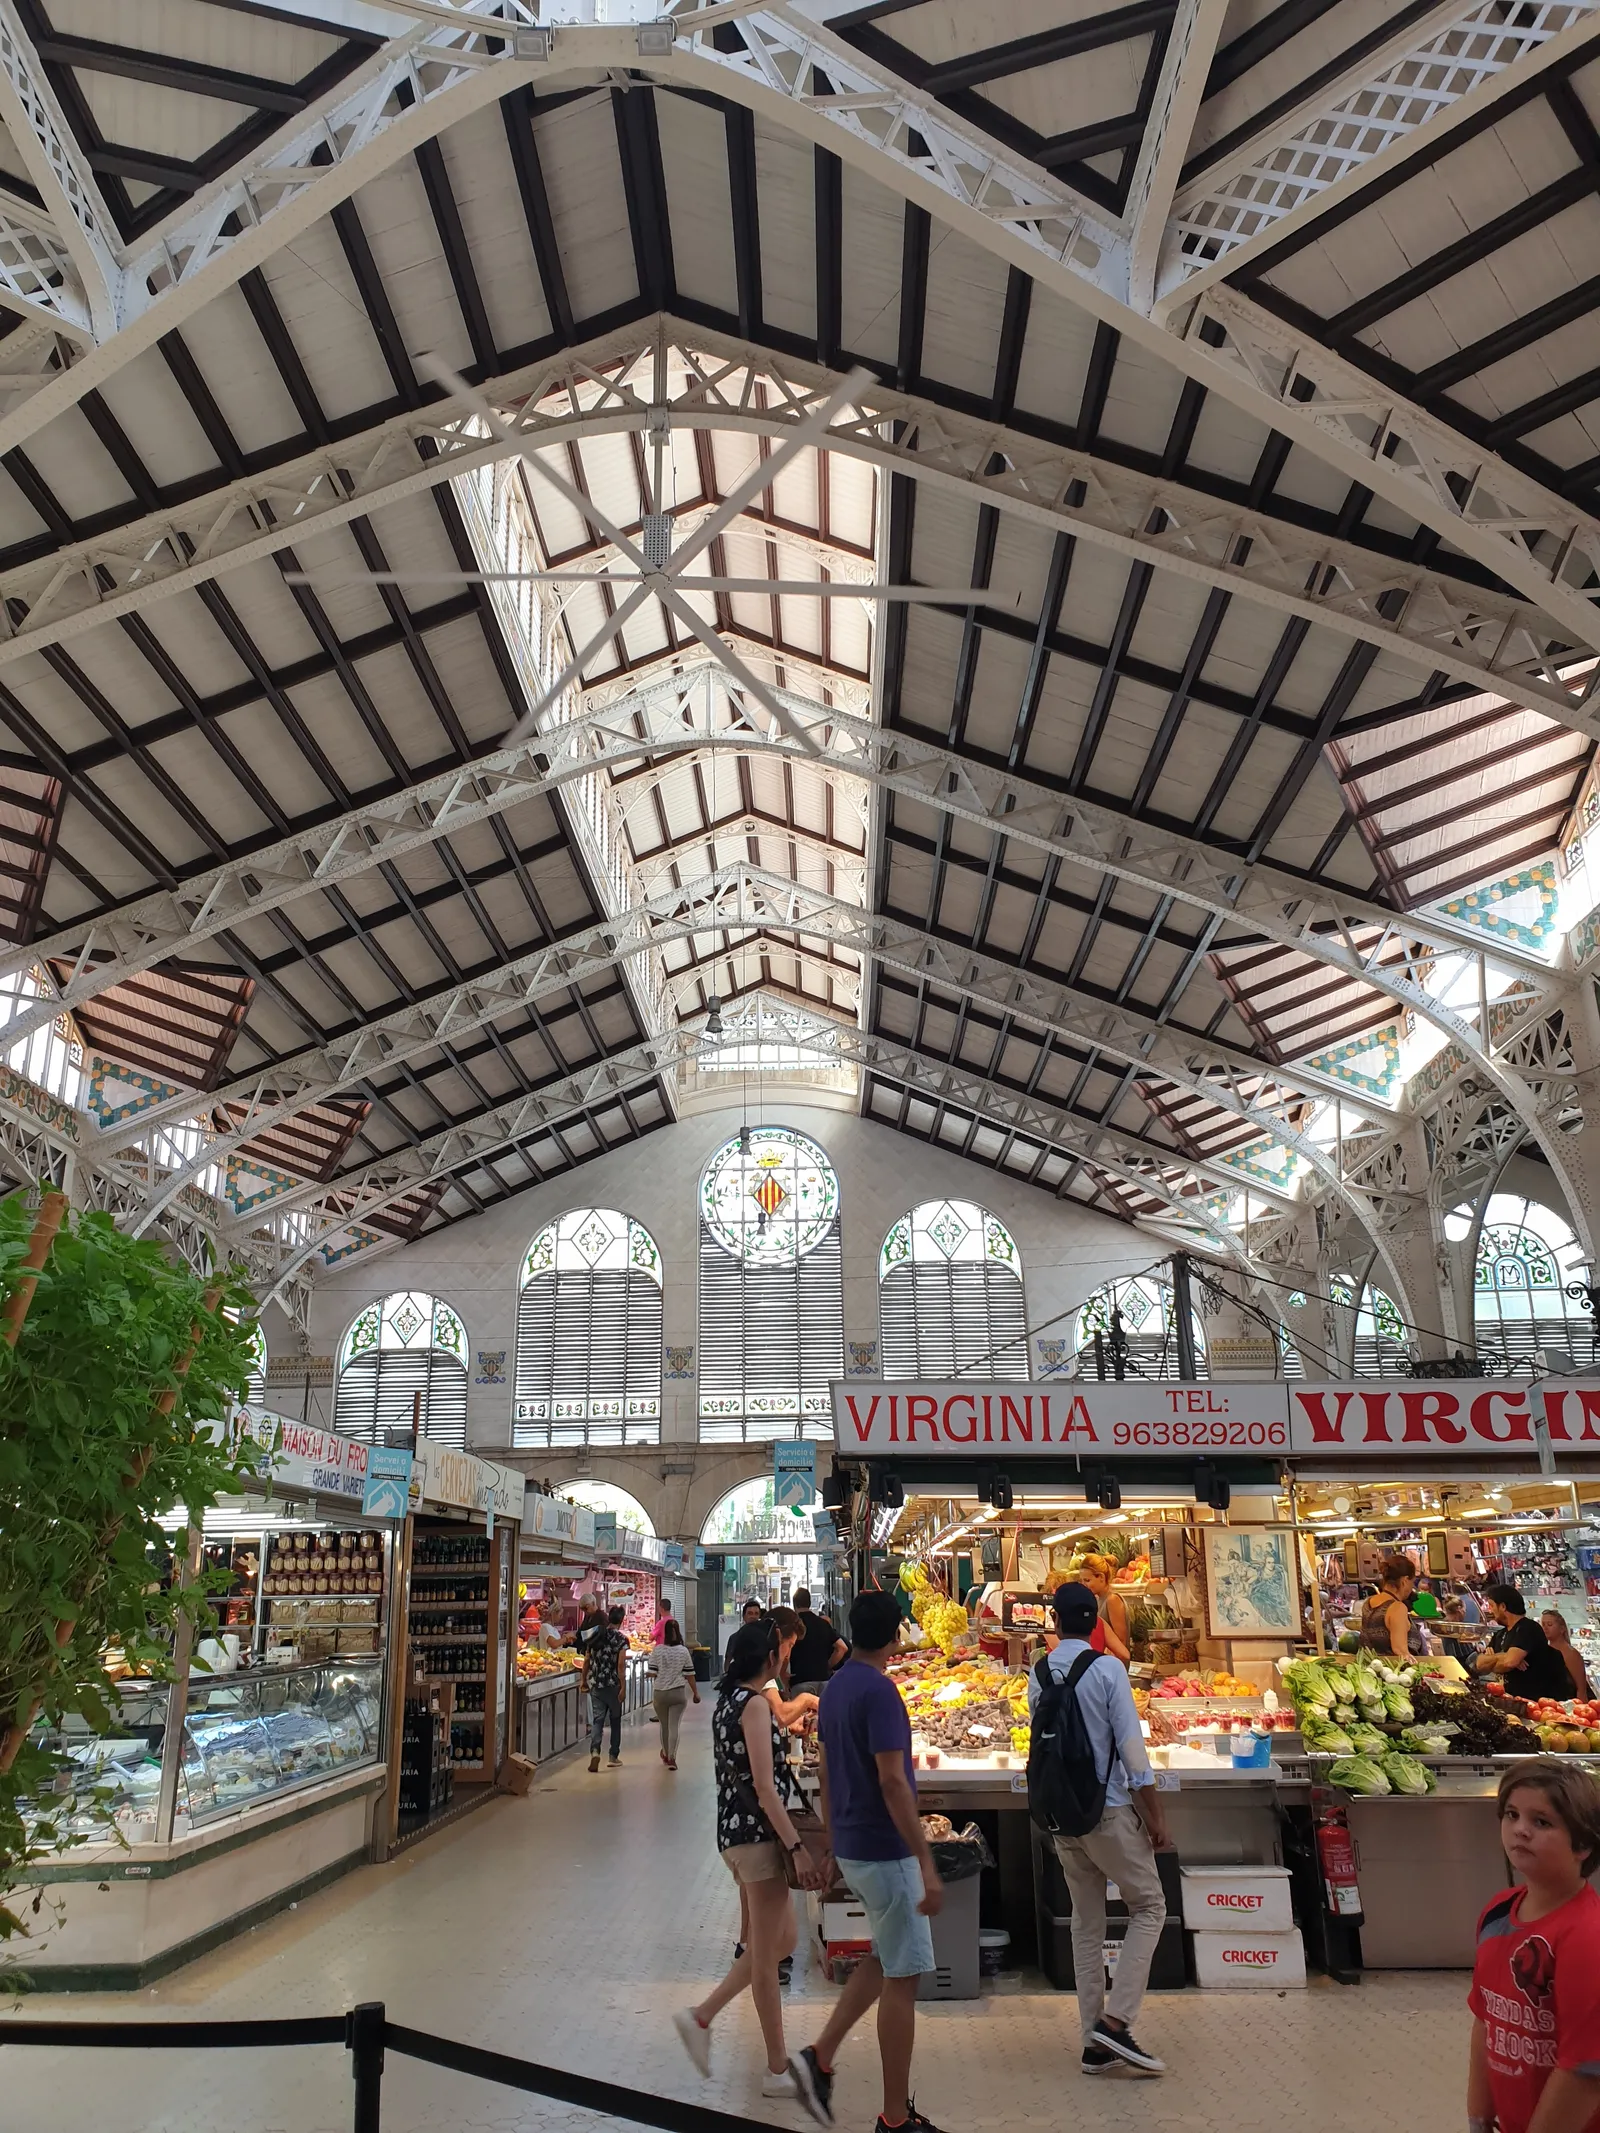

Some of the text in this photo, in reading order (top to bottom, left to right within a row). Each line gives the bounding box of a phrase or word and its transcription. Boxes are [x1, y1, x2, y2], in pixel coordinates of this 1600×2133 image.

[1165, 1390, 1230, 1413] TEL:
[844, 1395, 1100, 1442] VIRGINIA
[282, 1422, 324, 1461] MAISON
[327, 1437, 343, 1466] DU
[1113, 1421, 1286, 1446] 963829206
[374, 1453, 399, 1464] Servei
[777, 1447, 808, 1457] Servicio
[778, 1456, 814, 1466] domicilio
[312, 1468, 340, 1491] GRANDE
[440, 1452, 477, 1506] CERVEZAS
[1207, 1893, 1264, 1909] CRICKET
[1222, 1950, 1278, 1964] CRICKET
[1494, 2026, 1559, 2067] ROCK
